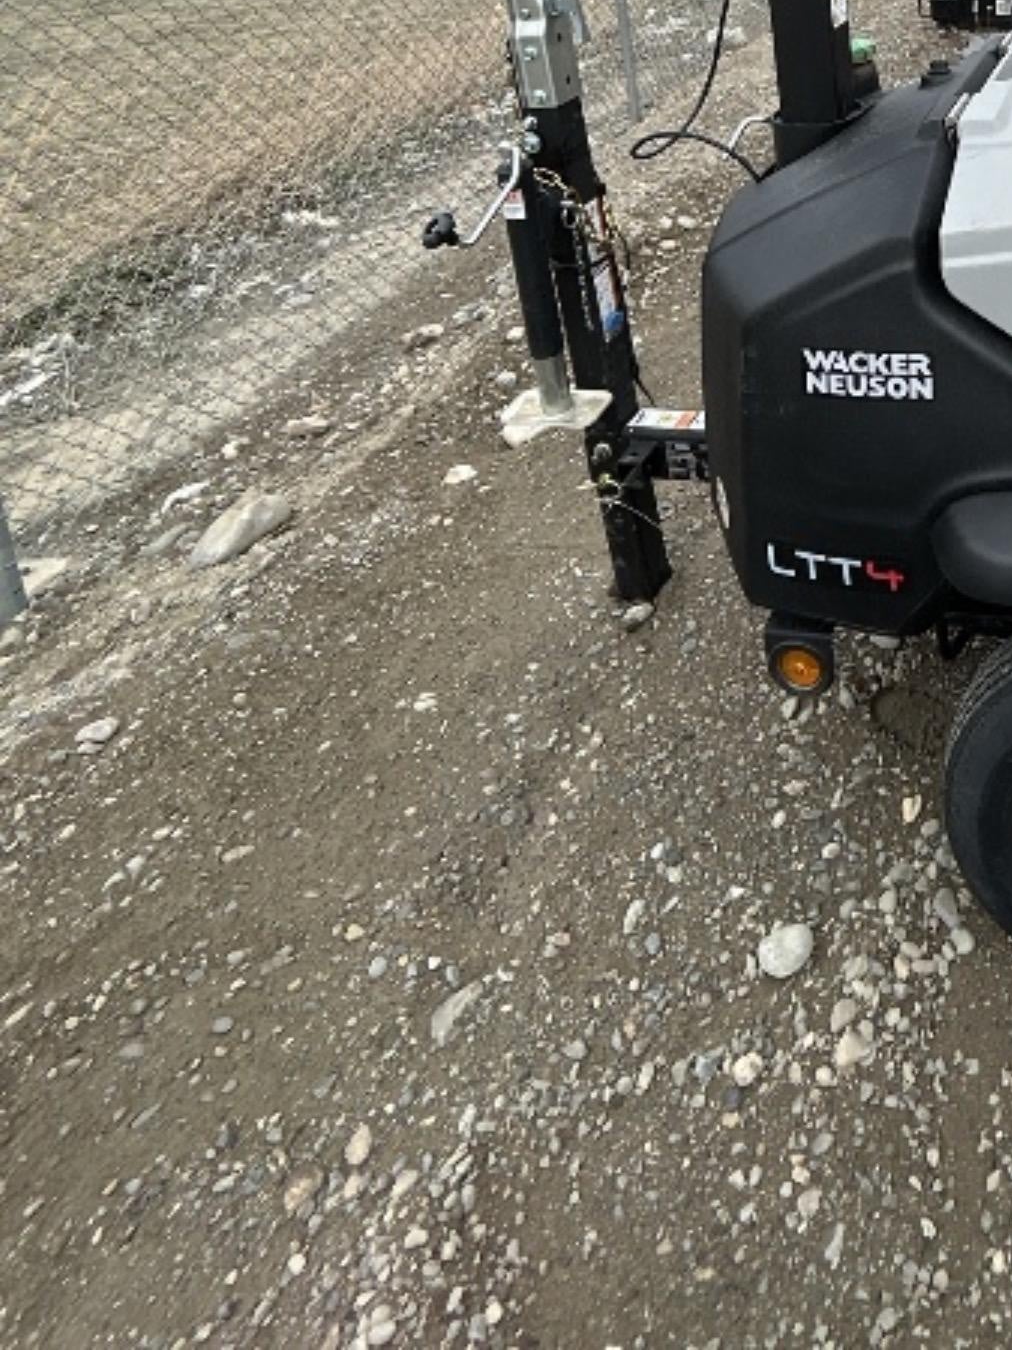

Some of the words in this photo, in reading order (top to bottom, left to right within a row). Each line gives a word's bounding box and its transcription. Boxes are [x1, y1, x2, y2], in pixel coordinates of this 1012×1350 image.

[802, 347, 932, 376] WACKER
[805, 374, 935, 401] NEUSON
[766, 542, 904, 592] LTT4
